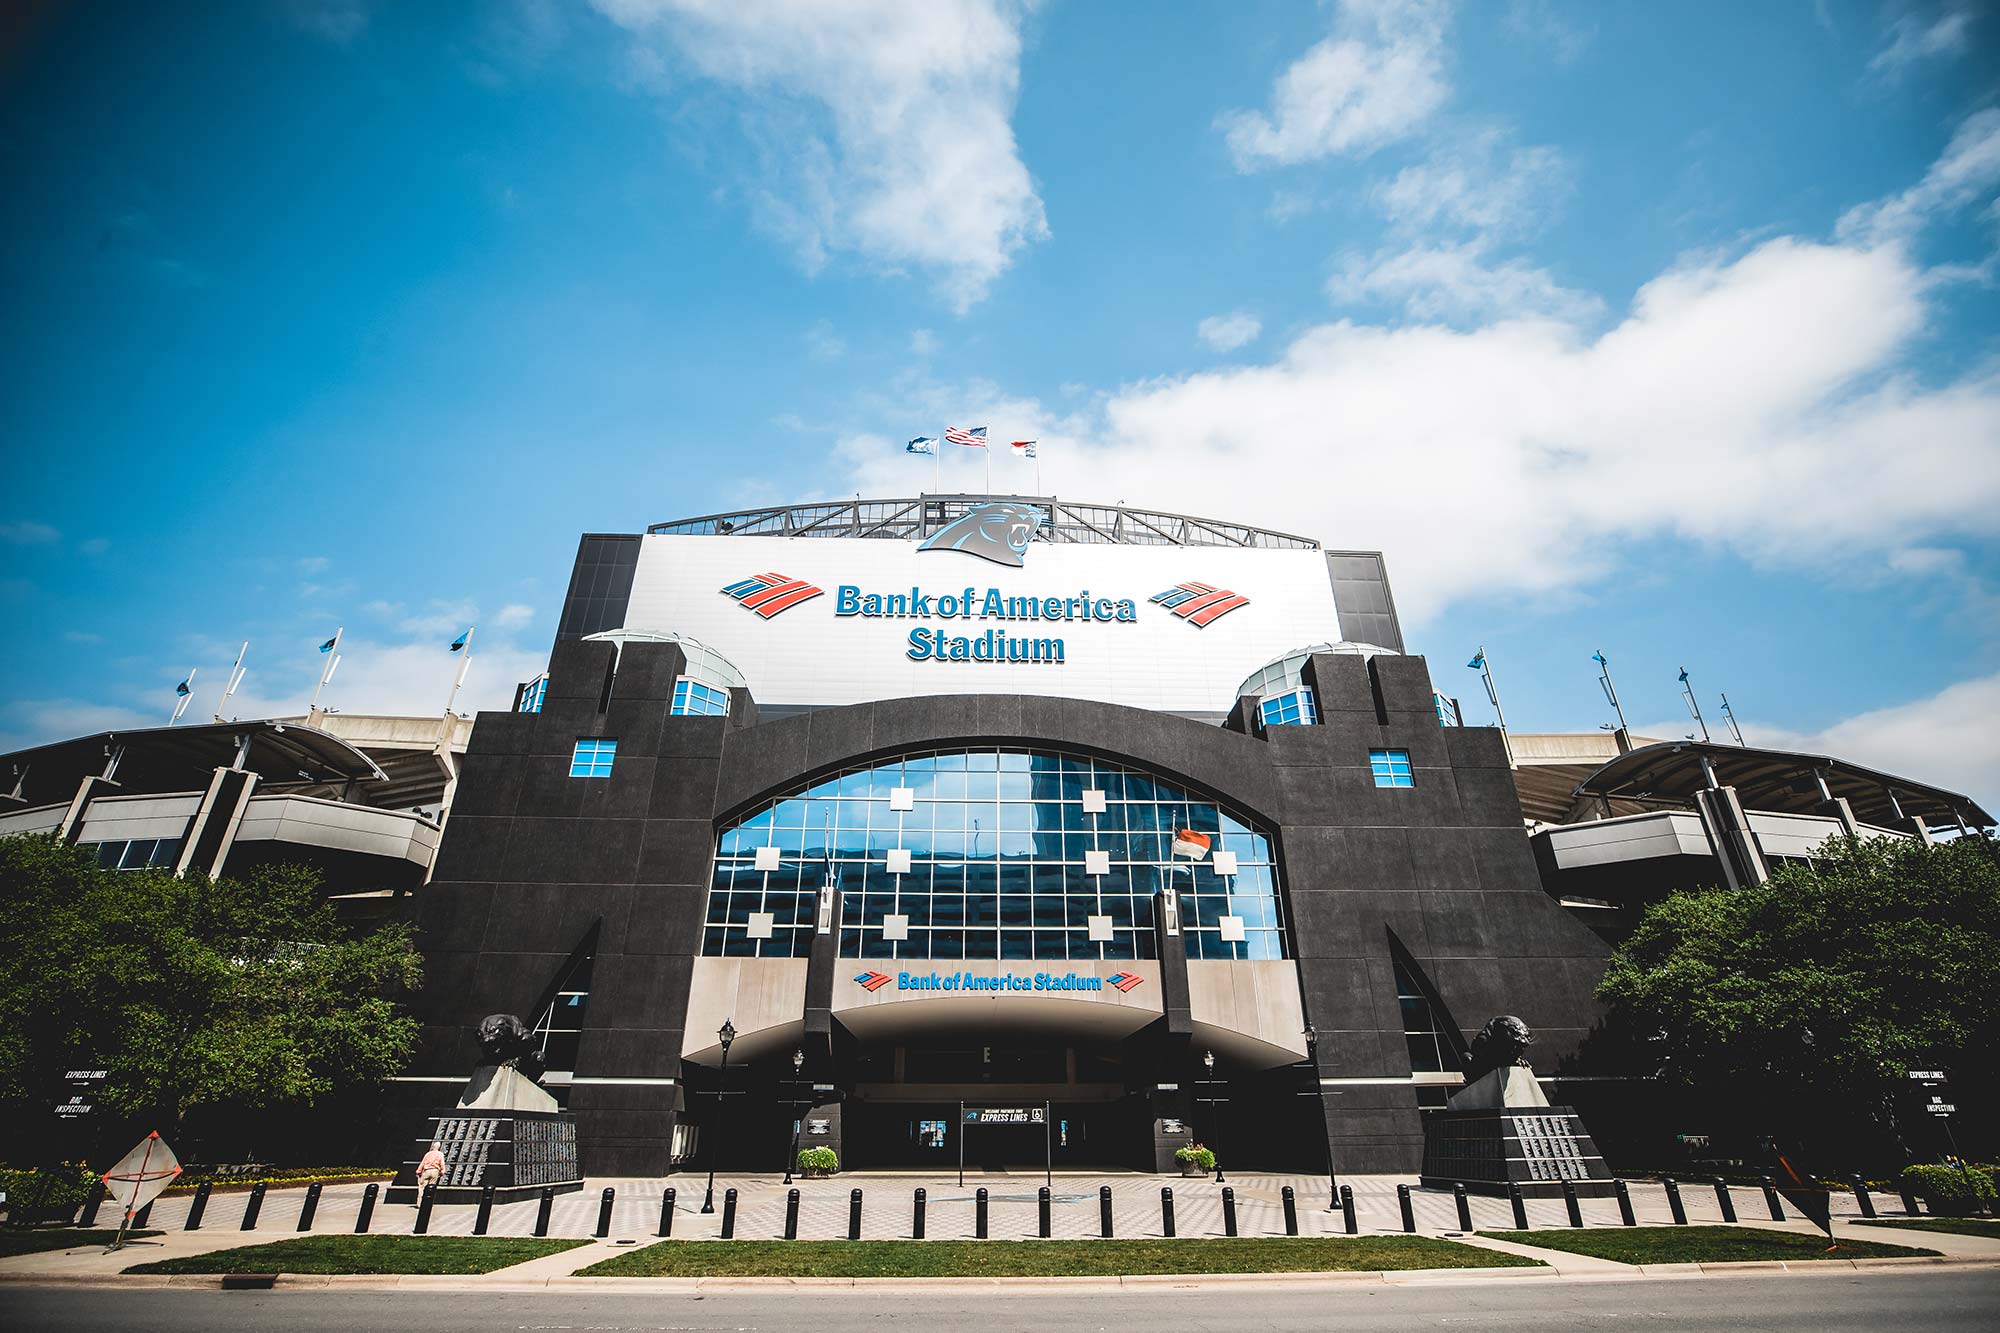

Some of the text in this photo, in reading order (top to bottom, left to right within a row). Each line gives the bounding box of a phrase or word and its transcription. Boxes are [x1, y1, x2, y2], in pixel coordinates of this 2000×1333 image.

[835, 585, 1137, 622] Bank of America
[906, 627, 1065, 663] Stadium
[898, 972, 1102, 991] Bank of America Stadium
[1909, 1071, 1930, 1079] EXPRESS
[54, 1105, 92, 1113] INSPECTION
[1926, 1104, 1956, 1112] INSPECTION
[980, 1113, 1028, 1122] EXPRESS LINES
